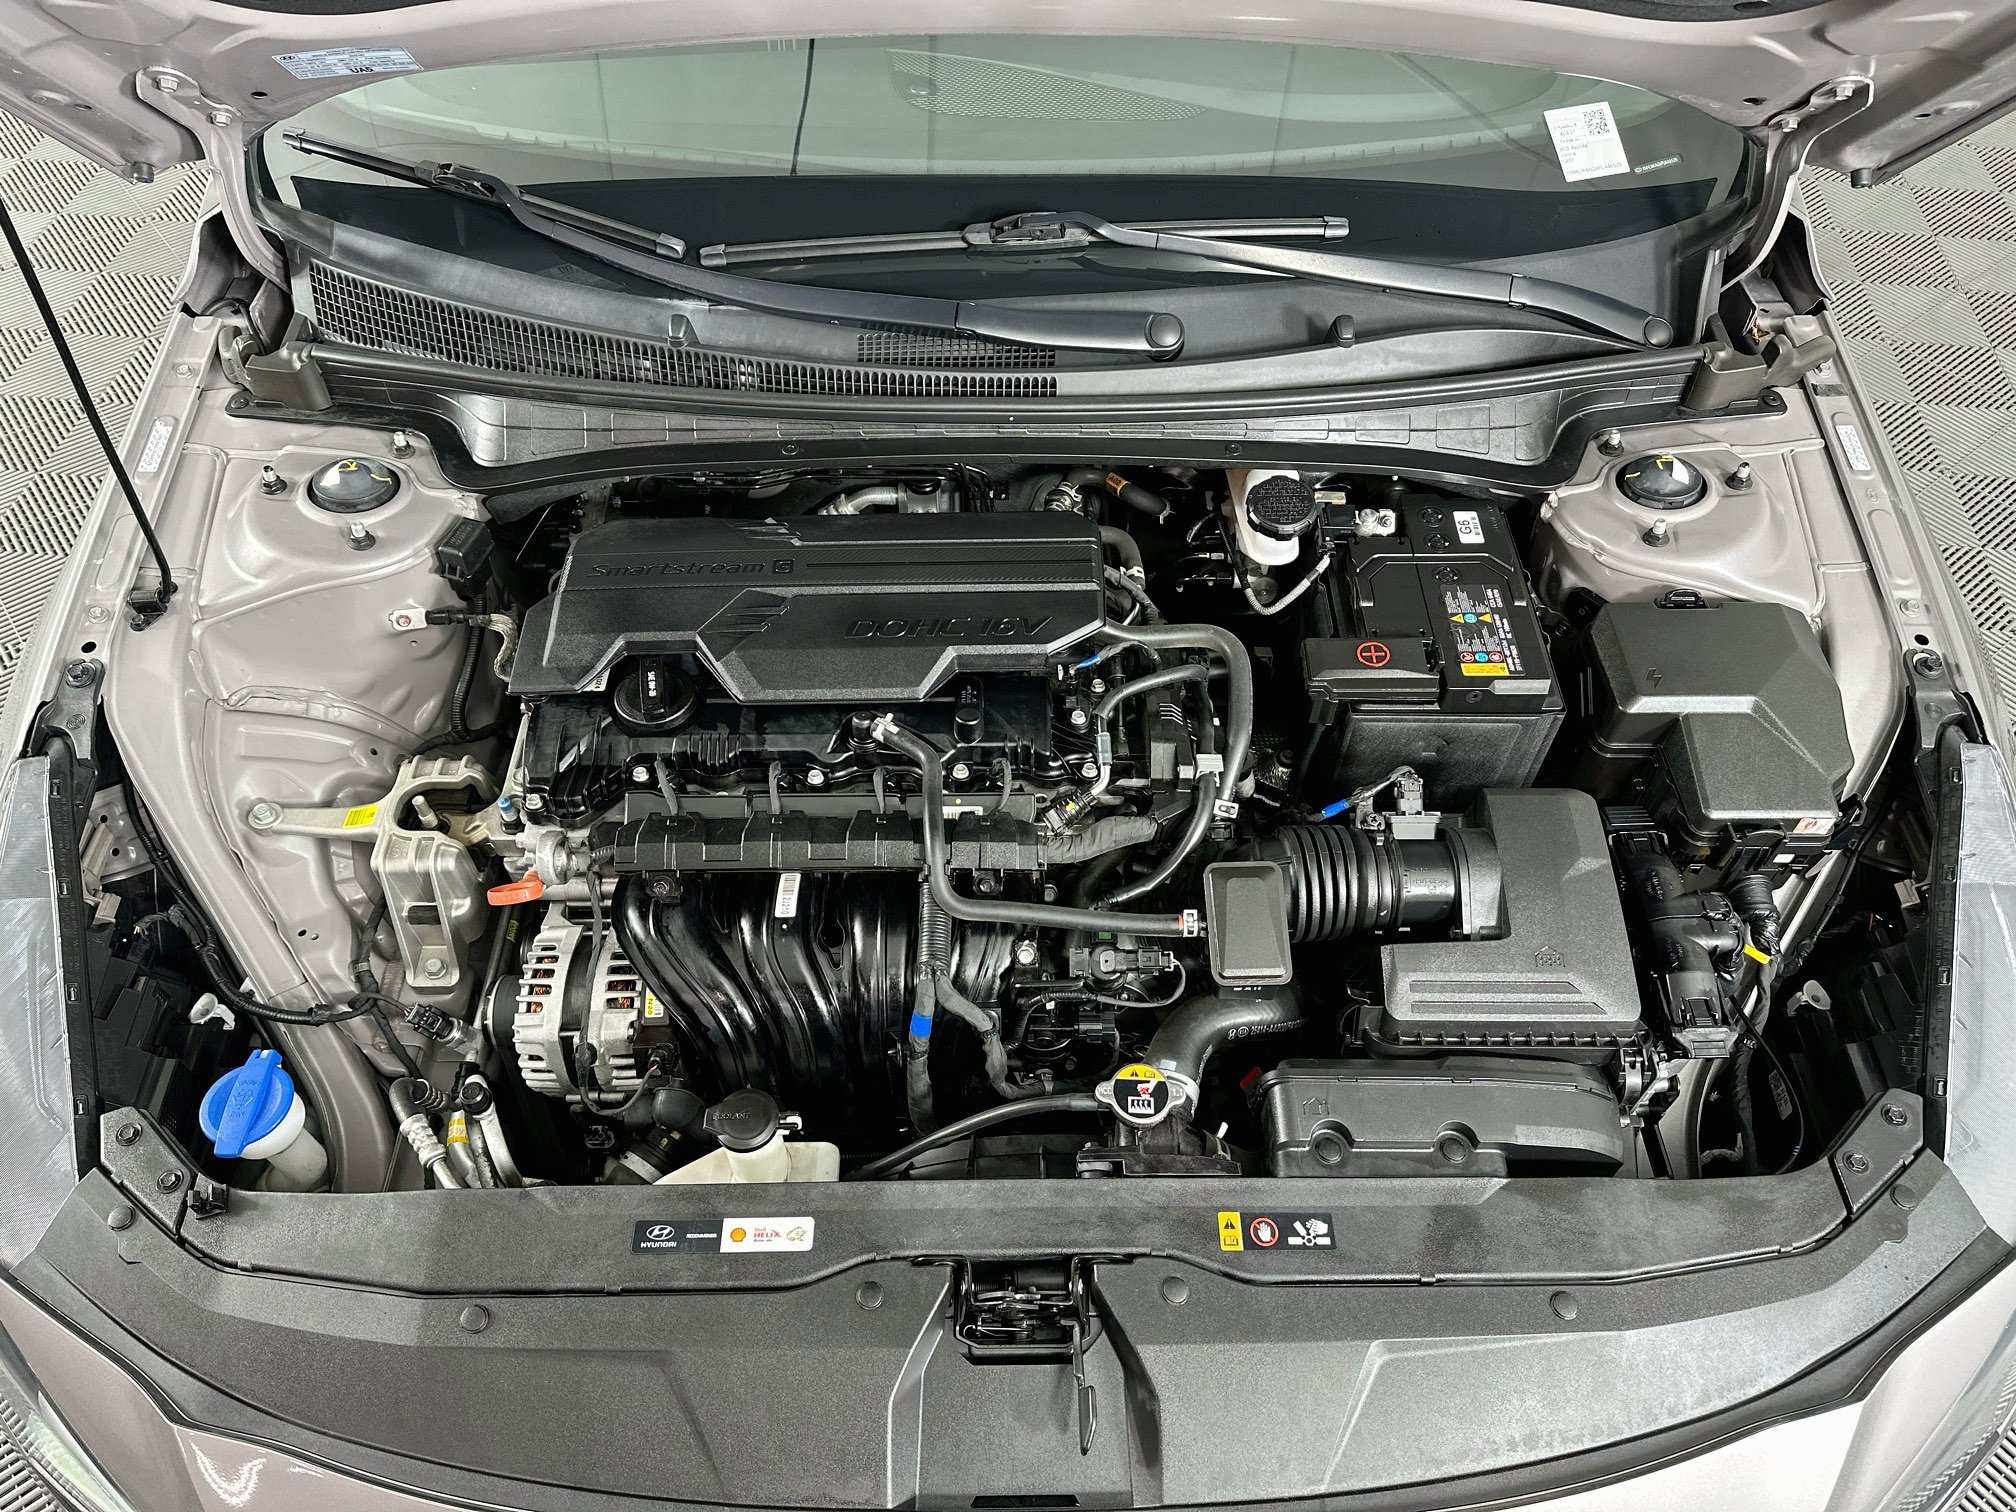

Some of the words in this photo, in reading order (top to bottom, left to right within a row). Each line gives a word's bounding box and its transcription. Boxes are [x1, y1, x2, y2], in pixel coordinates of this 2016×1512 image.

[1457, 520, 1472, 534] G6
[587, 561, 766, 577] Smartstream
[845, 617, 971, 639] DOHC
[977, 616, 1053, 636] 16V
[780, 897, 791, 914] 2J210
[1098, 1087, 1113, 1096] HCC
[754, 1230, 781, 1238] HELIX
